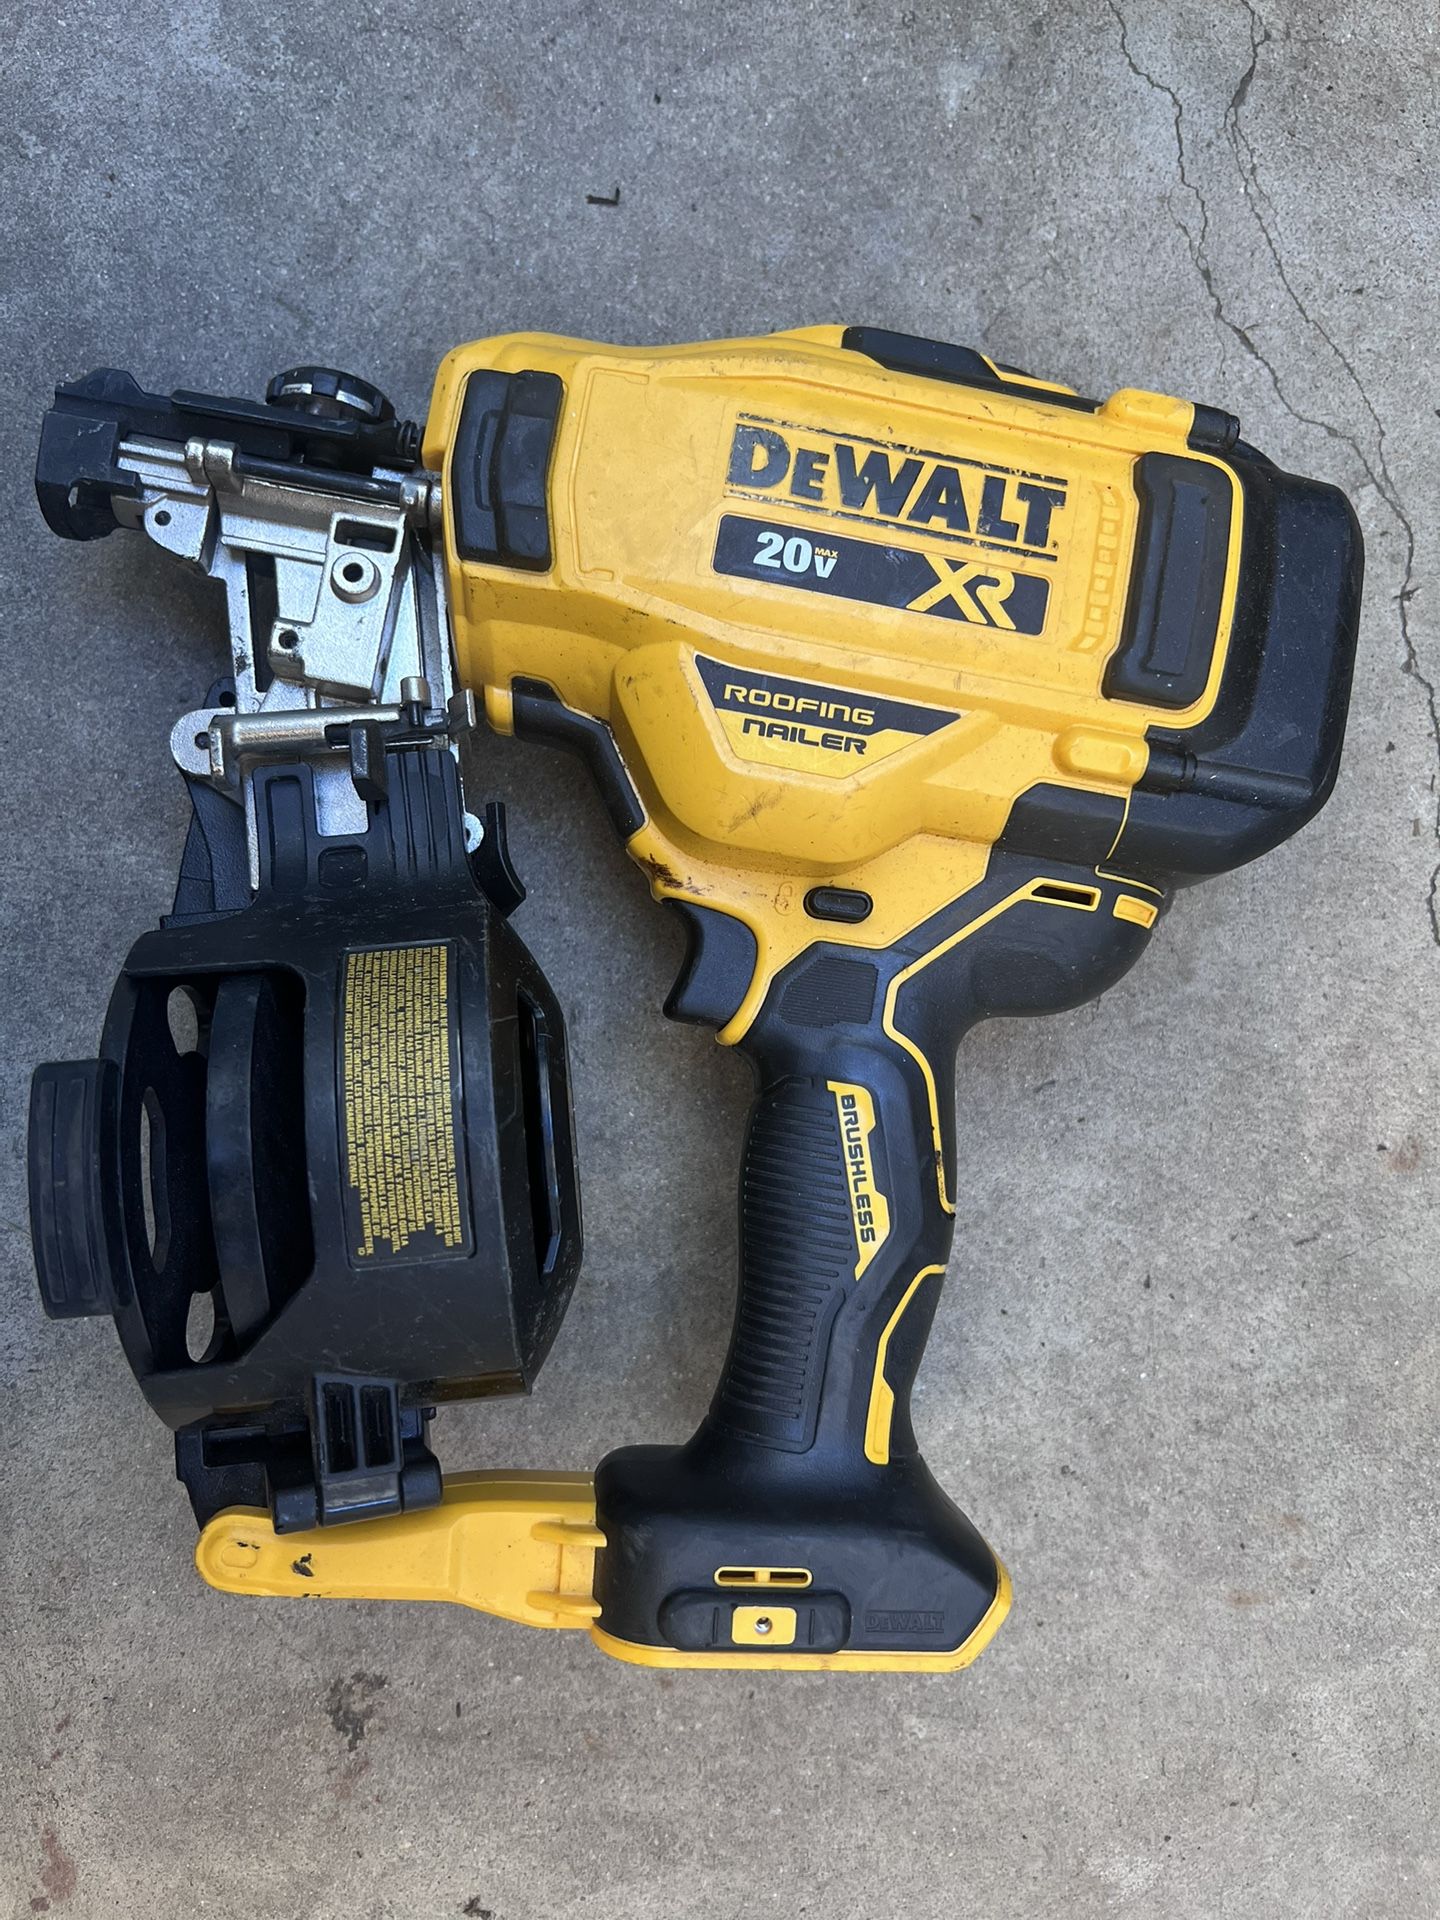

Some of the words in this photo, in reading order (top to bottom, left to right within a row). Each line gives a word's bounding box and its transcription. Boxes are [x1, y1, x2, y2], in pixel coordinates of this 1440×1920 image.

[814, 546, 838, 559] MAX
[905, 552, 1017, 631] XR
[723, 683, 876, 726] ROOFING
[742, 718, 868, 756] NAILER
[372, 959, 380, 977] JAMAIS
[439, 946, 448, 1002] AVERTISSEMENT:
[372, 979, 380, 1002] POINTER
[388, 995, 396, 1012] MODE
[345, 1014, 353, 1029] AVEC
[362, 1006, 371, 1034] BATTERIE
[371, 1003, 379, 1025] L'OUTIL
[345, 1043, 353, 1080] BATTERIES
[380, 1029, 388, 1082] FONCTIONNENT
[388, 1032, 397, 1062] TENSION
[397, 1022, 406, 1066] NEUTRALISEZ
[432, 1036, 442, 1078] PERSONNES
[440, 1028, 450, 1066] MINIMISER
[372, 1069, 380, 1087] VERS
[389, 1063, 398, 1096] LORSQUE
[398, 1068, 407, 1096] JAMAIS
[424, 1062, 433, 1094] DOIVENT
[372, 1089, 381, 1125] D'AUTRES
[390, 1097, 399, 1124] L'OUTIL
[425, 1095, 434, 1123] PORTER
[434, 1094, 444, 1131] UTILISENT
[442, 1082, 452, 1113] RISQUES
[345, 1102, 355, 1142] CHARGEUR
[381, 1084, 392, 1154] CONVENABLEMENT
[373, 1126, 384, 1172] PERSONNES
[392, 1138, 401, 1156] SERT
[401, 1135, 410, 1168] UTILISER
[408, 1098, 416, 1115] AFIN
[412, 1162, 425, 1231] FONCTIONNEMENT
[428, 1142, 439, 1179] LUNETTES
[436, 1133, 447, 1160] L'OUTIL
[376, 1174, 386, 1195] DANS
[385, 1156, 394, 1182] AVANT
[840, 1094, 876, 1243] BRUSHLESS
[386, 1184, 398, 1224] D'UTILISER
[396, 1177, 407, 1219] S'ASSURER
[404, 1180, 415, 1221] DISPOSITIF
[441, 1188, 452, 1232] PERSONNES
[448, 1172, 461, 1225] L'UTILISATEUR
[379, 1208, 389, 1228] ZONE
[453, 1226, 462, 1243] DOIT
